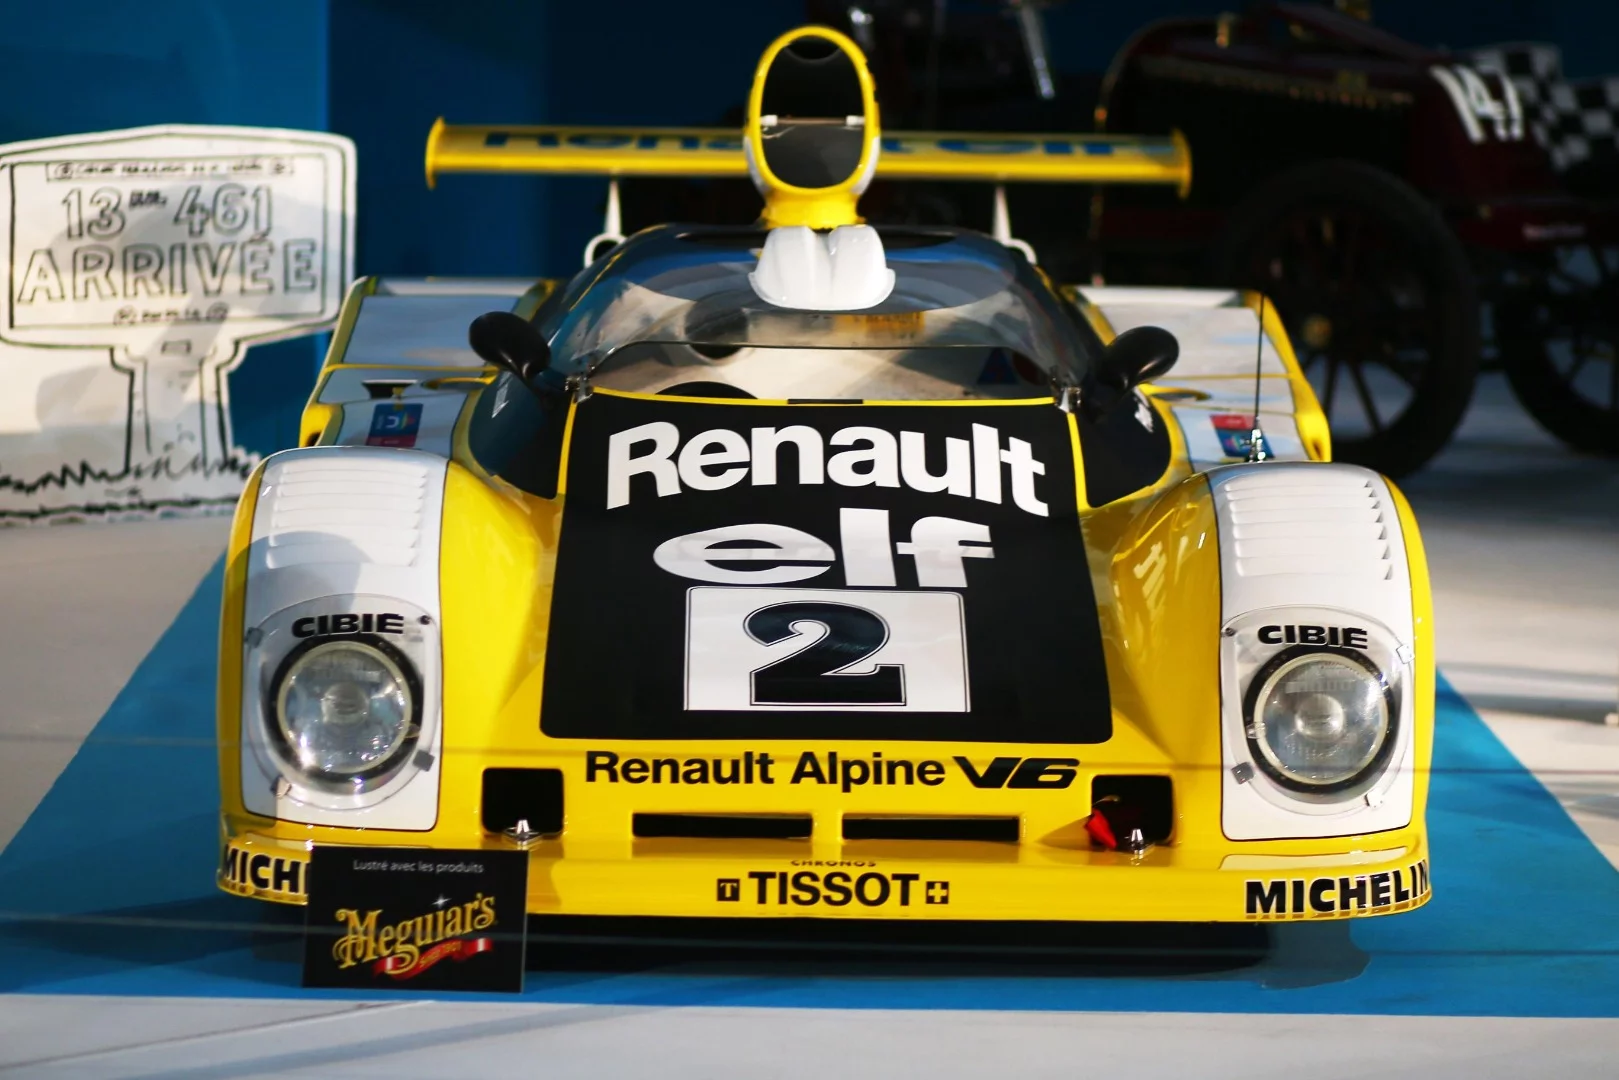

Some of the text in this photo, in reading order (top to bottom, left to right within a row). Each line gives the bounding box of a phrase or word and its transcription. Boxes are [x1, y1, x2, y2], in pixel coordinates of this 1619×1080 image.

[62, 183, 273, 241] 13 461
[607, 421, 1049, 517] Renault
[653, 508, 995, 587] elf
[743, 600, 906, 706] 2
[586, 751, 1080, 793] Renault Alpine V6
[223, 844, 309, 895] MICH
[353, 859, 484, 874] Lustré avec les produits
[748, 871, 920, 907] TISSOT
[790, 859, 876, 867] CHRONOS
[332, 892, 496, 975] Meguiar's
